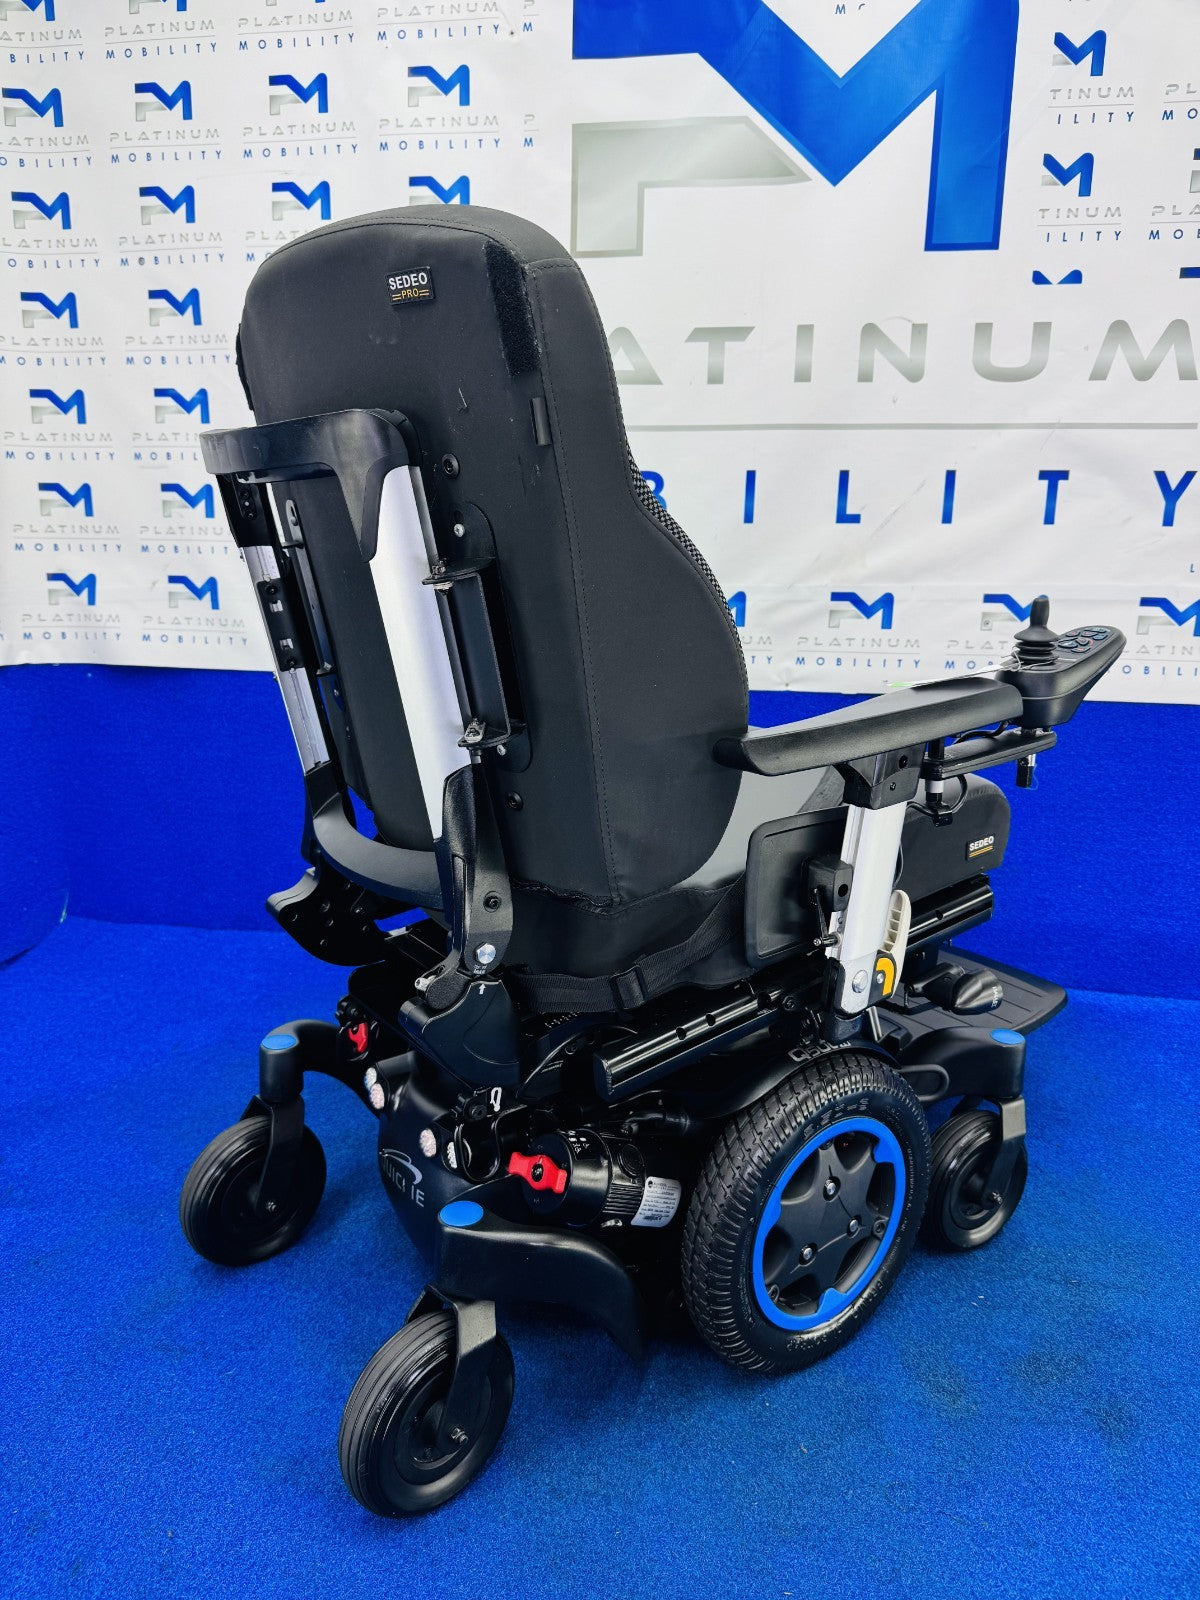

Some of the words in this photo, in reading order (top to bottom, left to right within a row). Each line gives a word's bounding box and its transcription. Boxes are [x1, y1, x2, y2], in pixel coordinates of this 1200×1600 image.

[376, 2, 499, 18] PLATINUM
[237, 9, 353, 28] PLATINUM
[104, 19, 215, 37] PLATINUM
[377, 24, 500, 41] MOBILITY
[523, 22, 533, 32] M
[238, 32, 355, 51] MOBILITY
[9, 51, 84, 64] BILITY
[106, 42, 217, 60] MOBILITY
[1049, 86, 1135, 100] TINUM
[1165, 82, 1198, 96] PL
[523, 113, 536, 125] P
[1056, 111, 1135, 125] ILITY
[1161, 108, 1199, 121] MO
[242, 120, 356, 138] PLATINUM
[378, 115, 499, 130] PLATINUM
[0, 134, 89, 147] ATINUM
[109, 128, 220, 142] PLATINUM
[379, 138, 501, 152] MOBILITY
[523, 137, 534, 148] M
[111, 150, 222, 164] MOBILITY
[243, 143, 358, 159] MOBILITY
[1038, 206, 1122, 219] TINUM
[2, 237, 98, 248] LATINUM
[118, 231, 223, 246] PLATINUM
[1046, 230, 1122, 243] ILITY
[8, 258, 99, 269] OBILITY
[388, 272, 429, 291] SEDEO
[401, 287, 420, 299] PRO
[125, 333, 228, 346] PLATINUM
[126, 354, 231, 366] MOBILITY
[4, 430, 113, 442] PLATINUM
[6, 450, 115, 461] MOBILITY
[13, 523, 120, 535] PLATINUM
[15, 542, 122, 552] MOBILITY
[21, 613, 120, 623] PLATINUM
[143, 614, 246, 628] PLATINUM
[23, 631, 121, 641] MOBILITY
[142, 634, 248, 646] MOBILITY
[797, 636, 920, 648] PLATINUM
[751, 656, 773, 665] TY
[795, 656, 921, 669] MOBILITY
[969, 835, 995, 852] SEDEO
